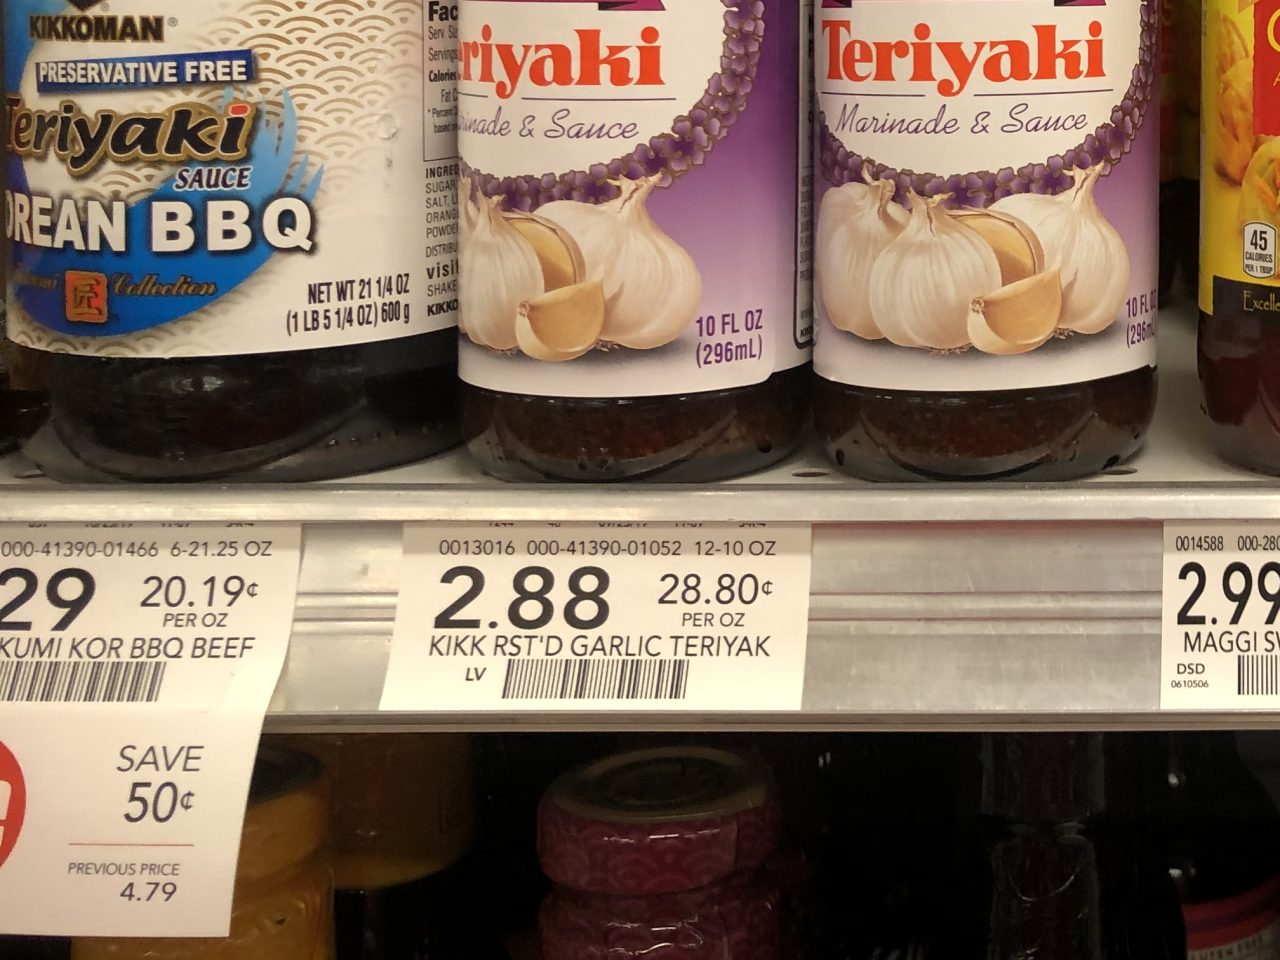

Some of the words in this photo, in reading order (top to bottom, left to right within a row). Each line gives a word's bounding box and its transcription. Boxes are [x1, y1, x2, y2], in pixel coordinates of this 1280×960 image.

[29, 15, 164, 42] KIKKOMAN
[821, 20, 1107, 97] Teriyaki
[39, 62, 177, 84] PRESERVATIVE
[185, 60, 247, 82] FREE
[544, 109, 640, 140] Sauce
[835, 103, 961, 135] Marinade
[1001, 102, 1088, 133] Sauce
[174, 167, 253, 191] SAUCE
[152, 198, 314, 254] BBQ
[1250, 230, 1268, 250] 45
[308, 282, 332, 304] NET
[381, 300, 400, 323] 600
[696, 339, 764, 369] (296mL)
[0, 541, 159, 557] 000-41390-01466
[170, 541, 239, 557] 6-21.25
[439, 540, 515, 556] 0013016
[527, 540, 682, 556] 000-41390-01052
[695, 540, 743, 556] 12-10
[1175, 536, 1224, 551] 0014588
[140, 575, 259, 609] 20.19¢
[433, 565, 611, 630] 2.88
[163, 613, 196, 628] PER
[681, 612, 714, 628] PER
[0, 637, 62, 658] KUMI
[68, 637, 124, 658] KOR
[131, 637, 184, 660] BBQ
[191, 637, 256, 658] BEEF
[428, 635, 486, 657] KIKK
[493, 635, 563, 657] RST'D
[570, 635, 662, 657] GARLIC
[669, 635, 771, 657] TERIYAK
[1184, 631, 1257, 653] MAGGI
[1171, 680, 1209, 689] 0610506
[116, 745, 204, 773] SAVE
[123, 782, 195, 823] 50¢
[68, 862, 136, 877] PREVIOUS
[140, 863, 180, 877] PRICE
[119, 882, 177, 902] 4.79
